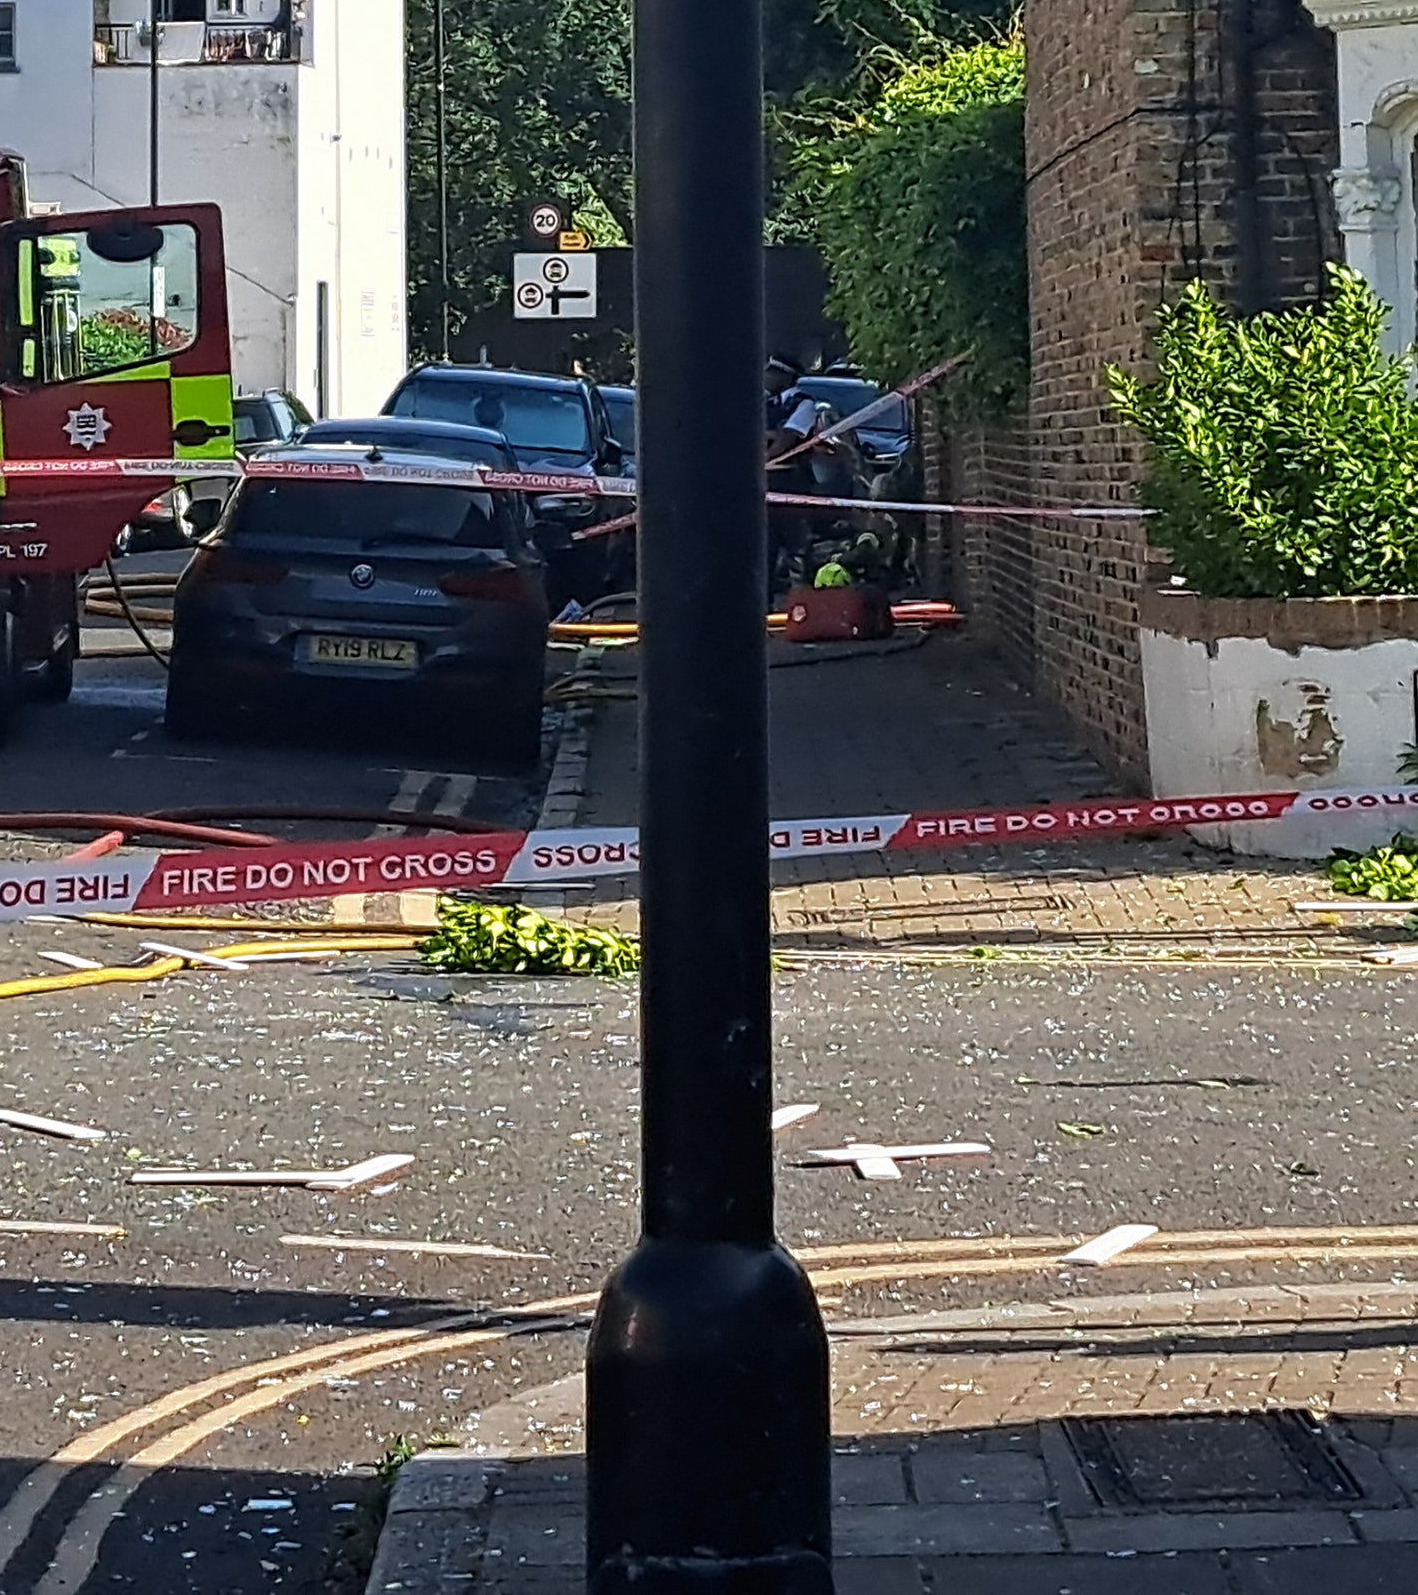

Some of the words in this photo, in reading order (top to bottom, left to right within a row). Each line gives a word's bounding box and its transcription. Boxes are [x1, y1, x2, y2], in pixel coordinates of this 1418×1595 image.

[535, 214, 556, 227] 20
[20, 543, 48, 557] 197
[317, 637, 361, 658] RY19
[367, 639, 406, 660] RLZ
[917, 817, 996, 838] FIRE
[1006, 812, 1059, 832] DO
[1066, 807, 1140, 829] NOT
[770, 831, 790, 848] D
[802, 826, 881, 847] FIRE
[162, 865, 237, 896] FIRE
[244, 862, 293, 890] DO
[302, 856, 371, 887] NOT
[379, 849, 496, 881] CROSS
[55, 873, 130, 904] FIRE
